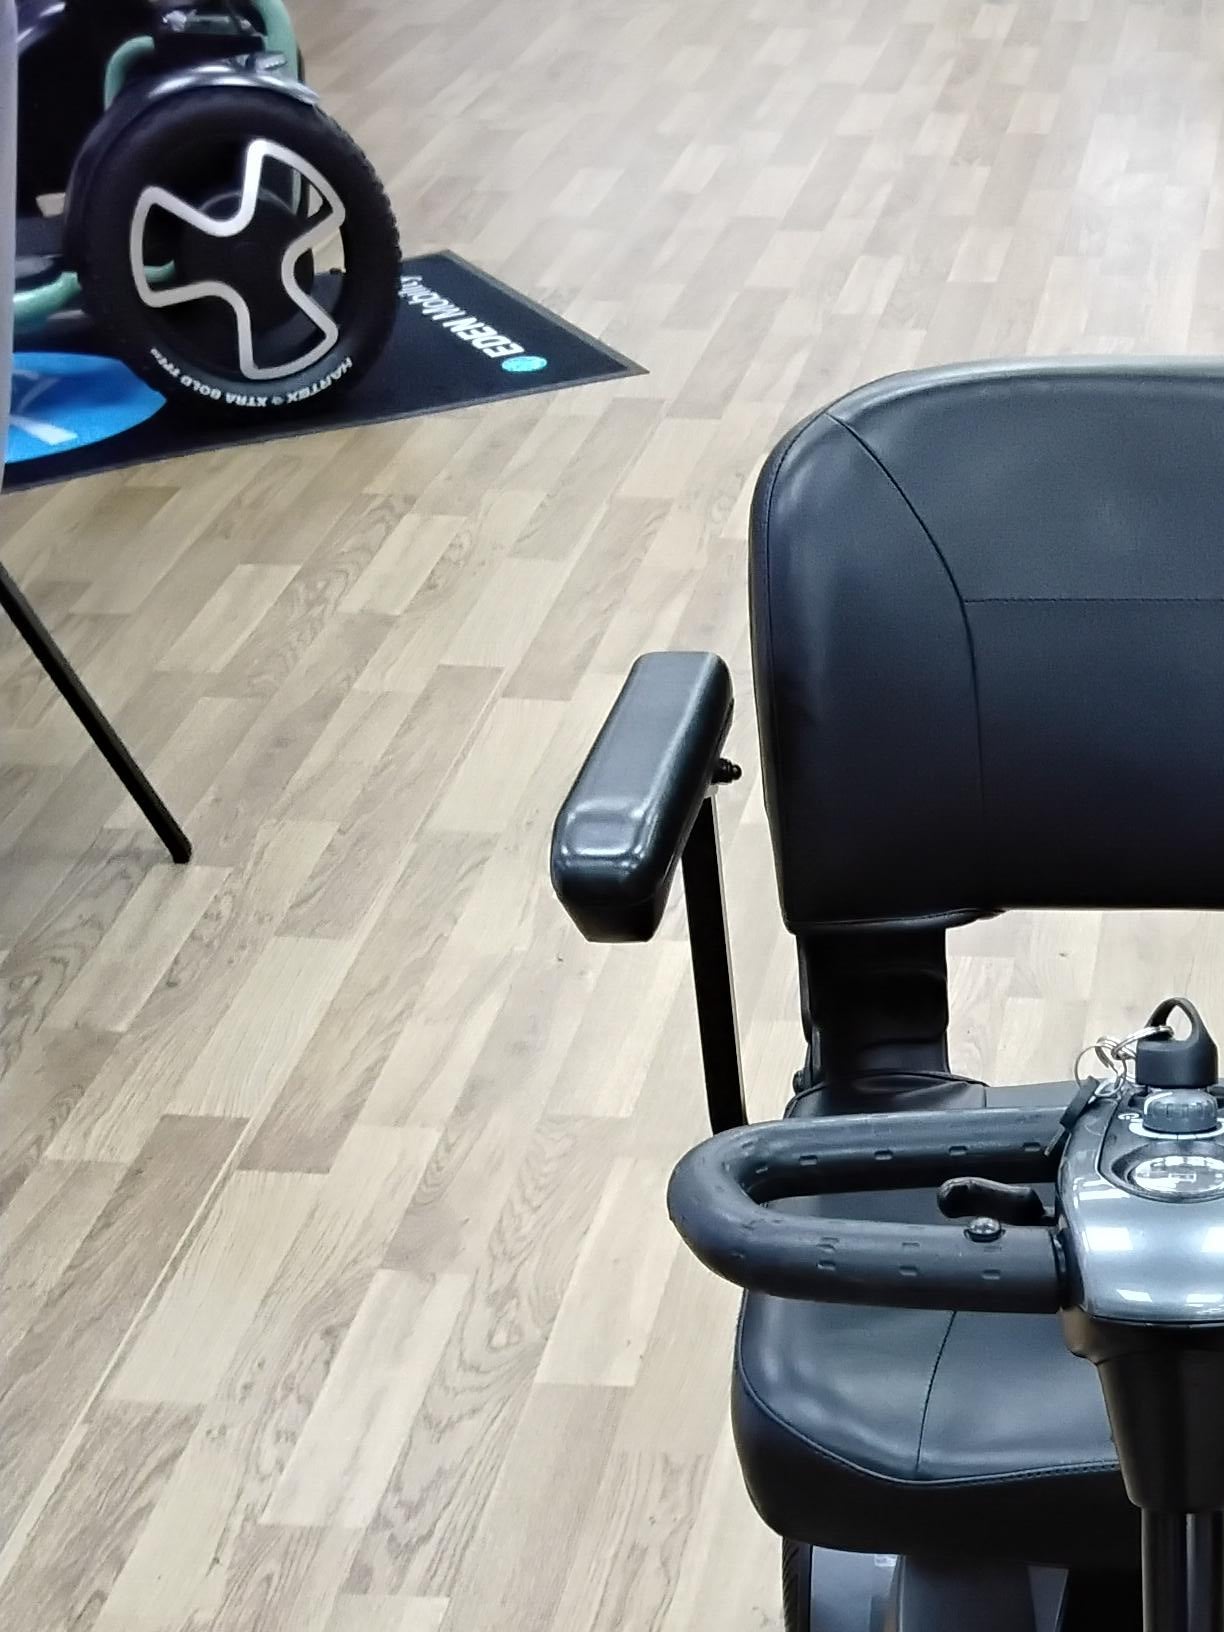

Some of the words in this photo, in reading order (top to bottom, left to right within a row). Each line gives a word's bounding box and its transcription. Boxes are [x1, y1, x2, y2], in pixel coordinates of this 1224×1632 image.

[398, 275, 467, 320] Mobility
[442, 316, 525, 358] EDEN
[180, 375, 223, 401] BOLD
[225, 392, 269, 408] XTRA
[286, 356, 354, 404] HARTEX
